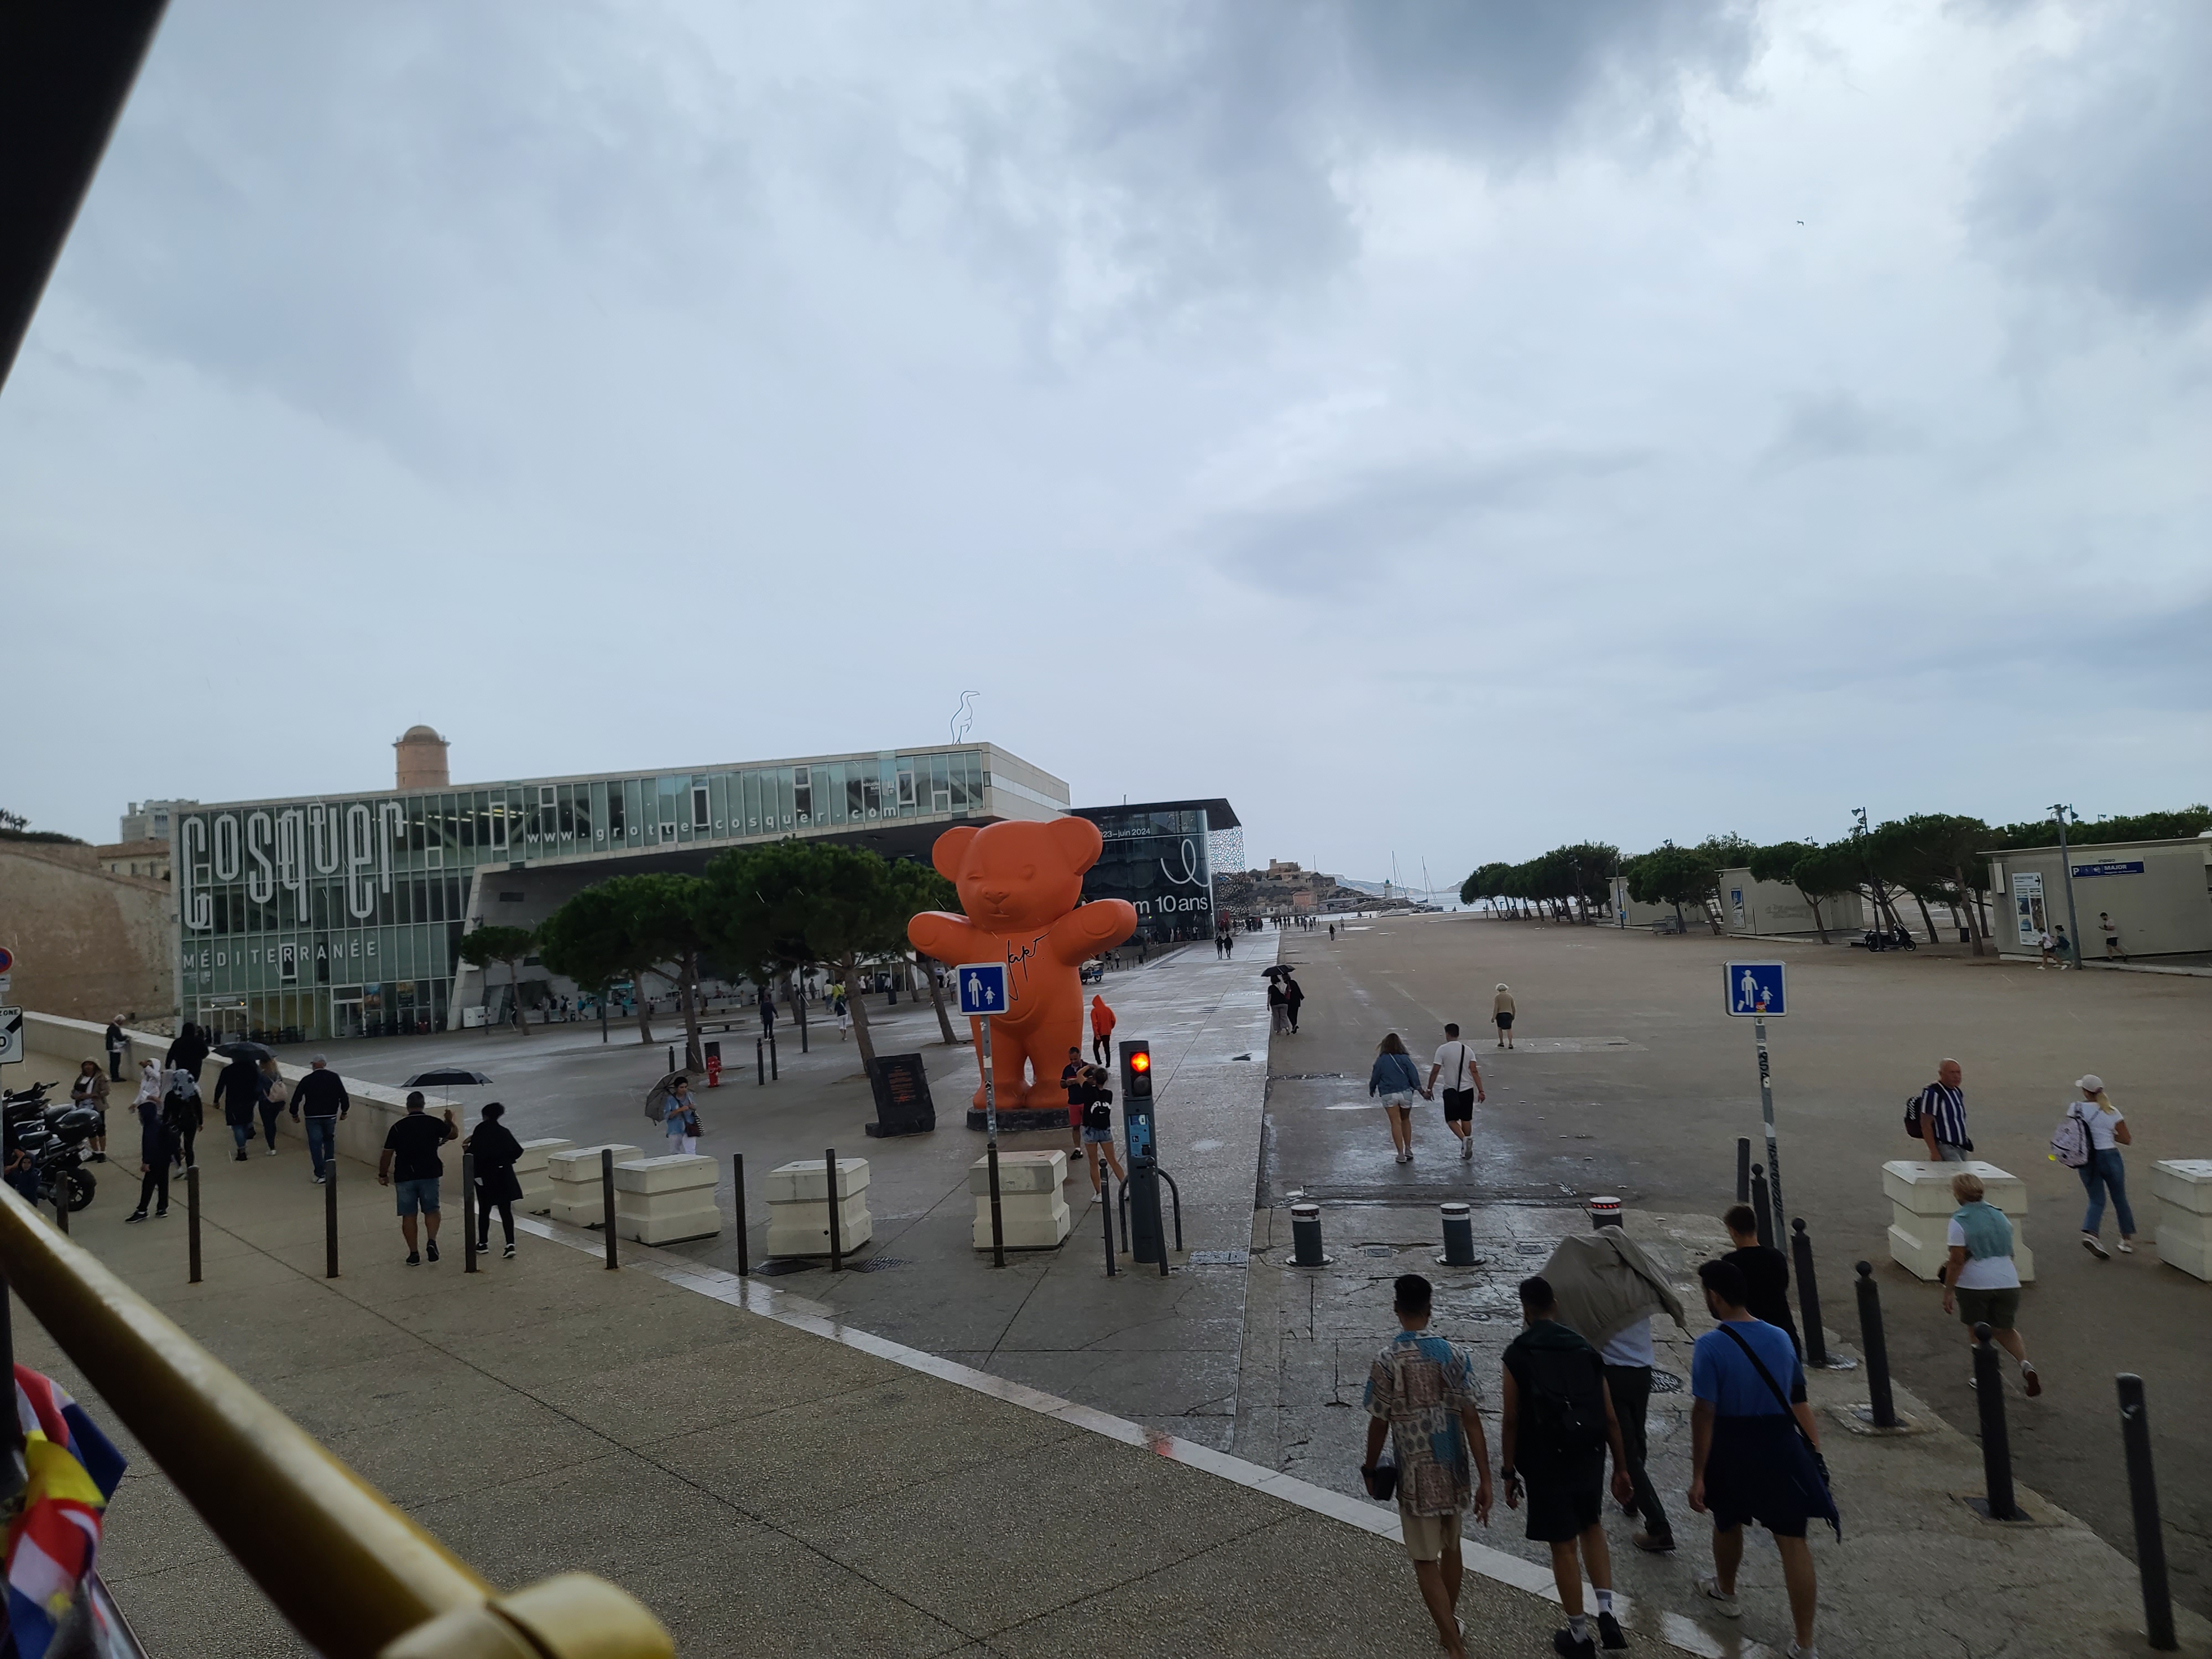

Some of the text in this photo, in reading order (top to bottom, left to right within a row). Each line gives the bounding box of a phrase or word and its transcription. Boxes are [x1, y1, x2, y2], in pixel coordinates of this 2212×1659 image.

[1131, 828, 1150, 836] 2024
[1155, 895, 1176, 912] 10
[1178, 896, 1208, 911] ans
[182, 940, 377, 968] MÉDITERRANÉE
